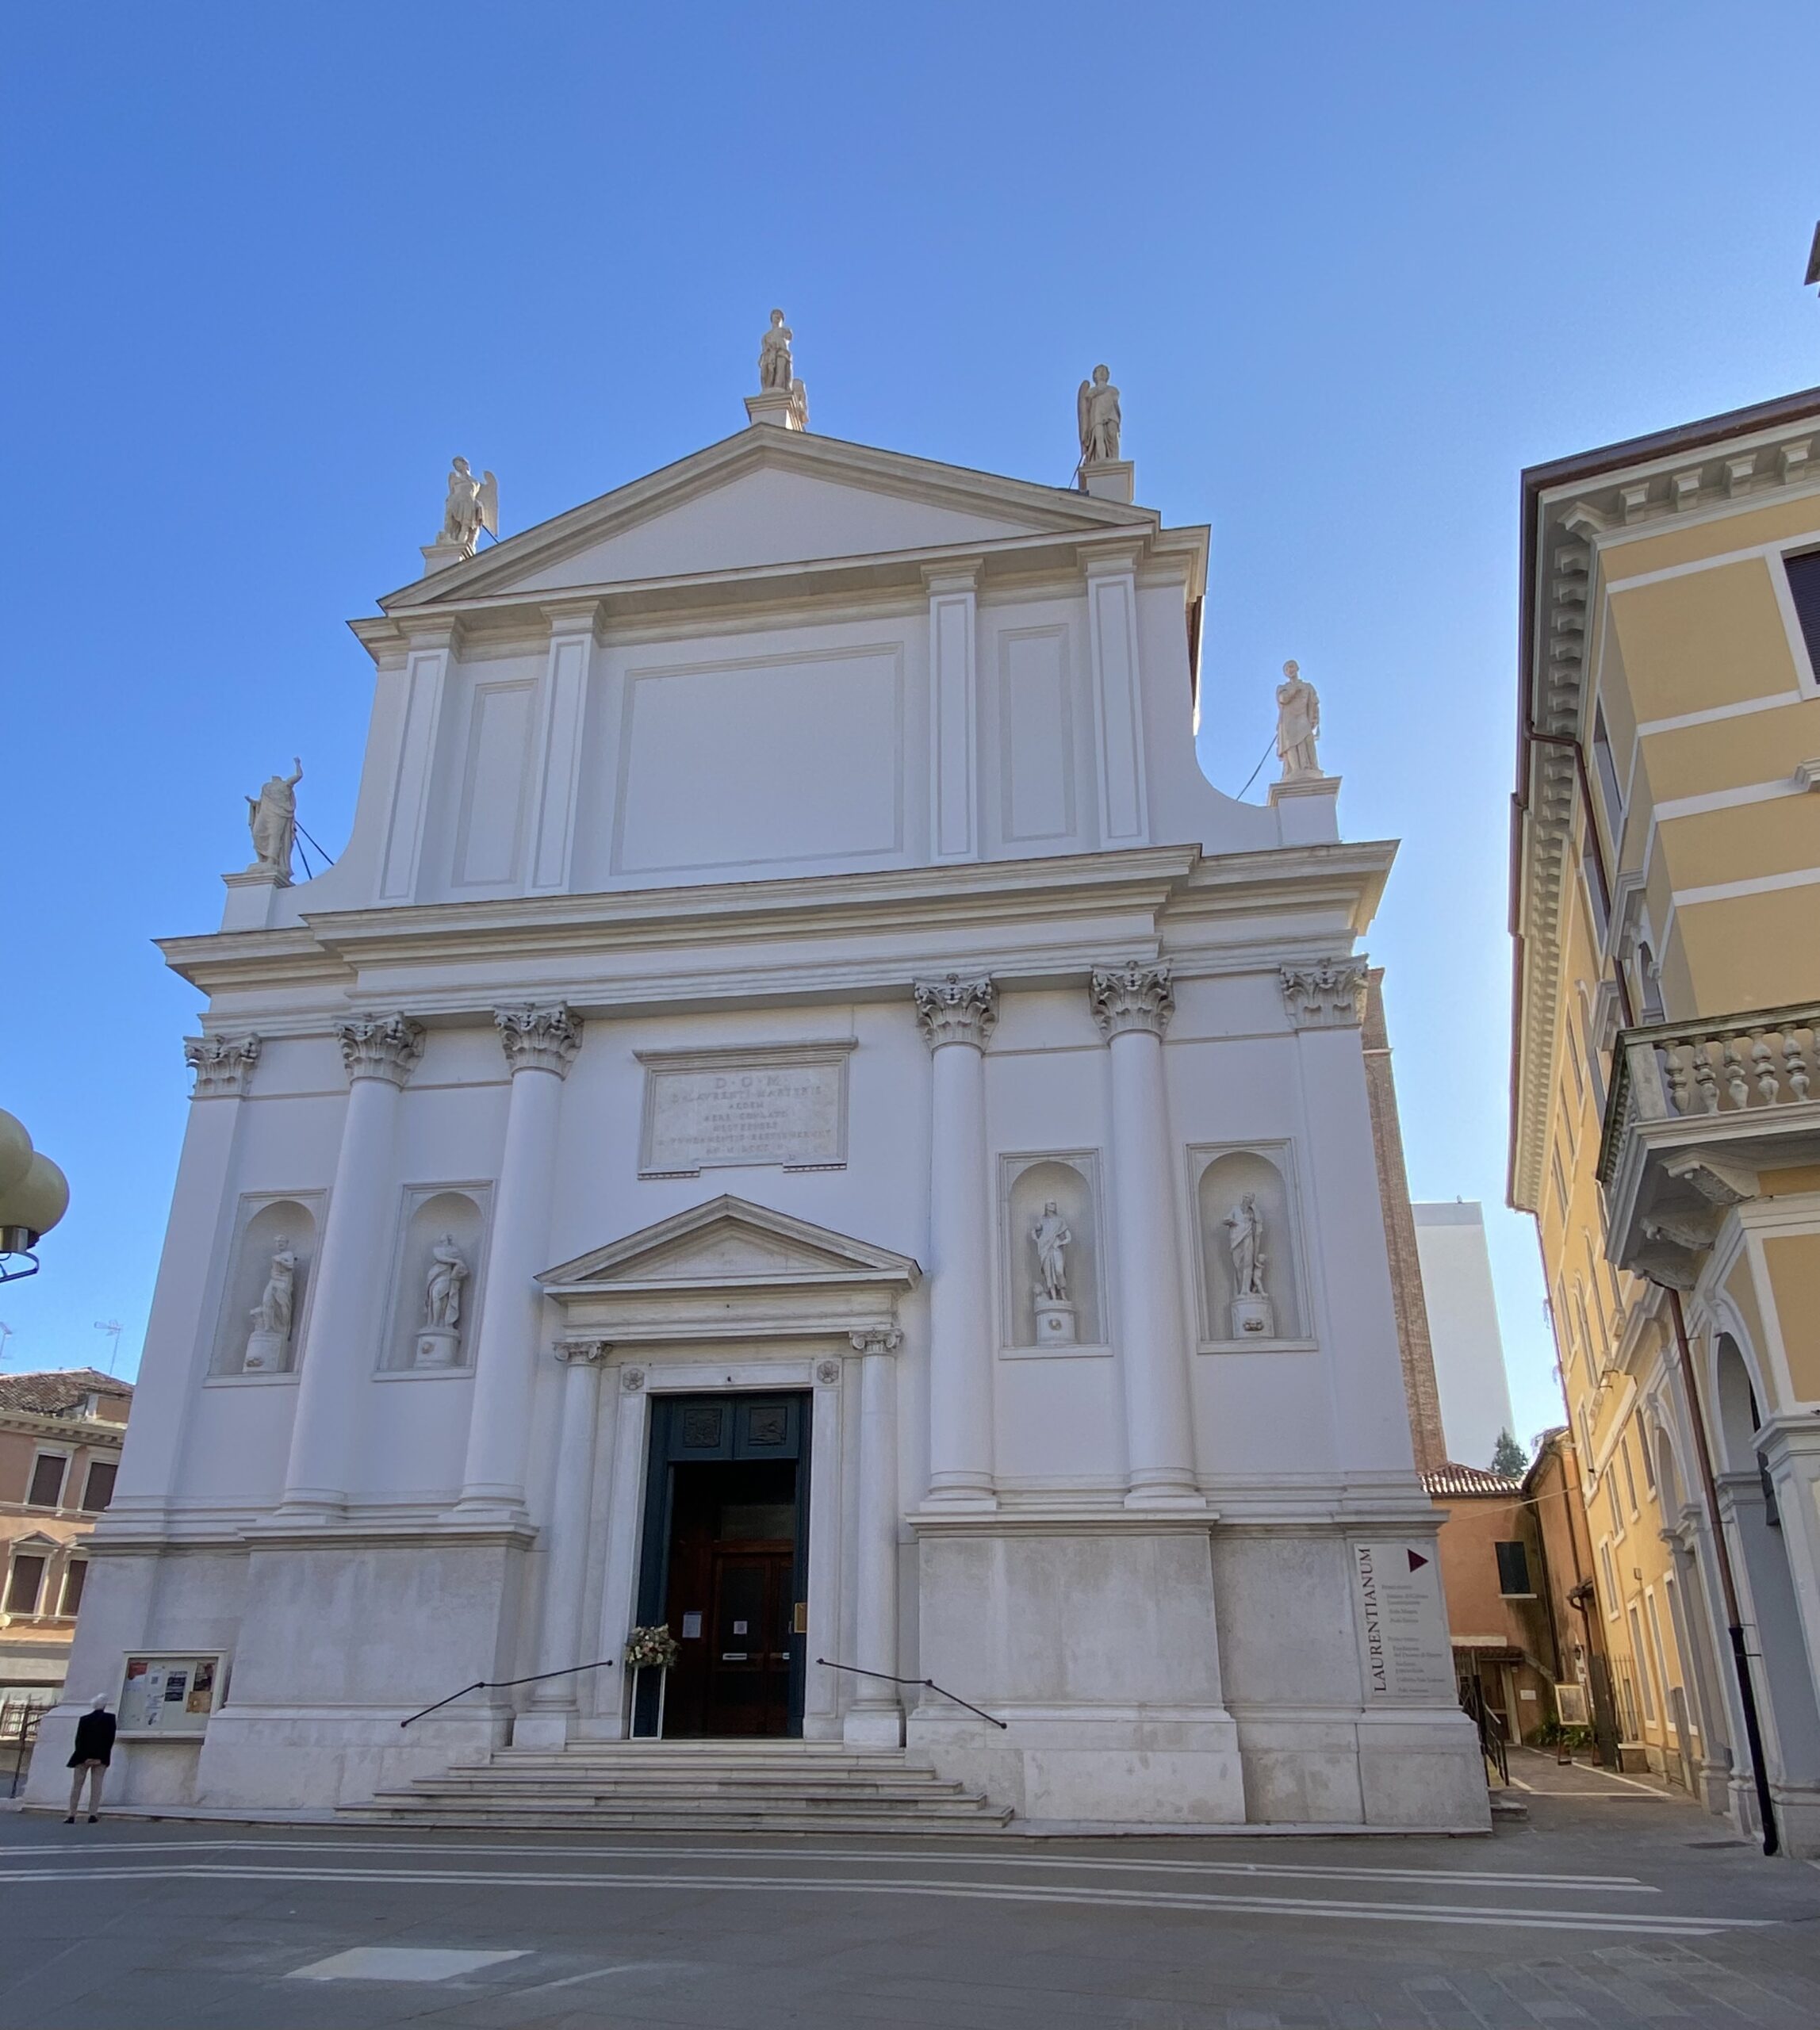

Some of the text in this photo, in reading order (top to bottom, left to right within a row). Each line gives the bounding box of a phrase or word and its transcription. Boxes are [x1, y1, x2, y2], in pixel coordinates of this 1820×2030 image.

[715, 1077, 727, 1090] D
[741, 1076, 753, 1088] O
[1358, 1548, 1386, 1692] LAURENTIANUM
